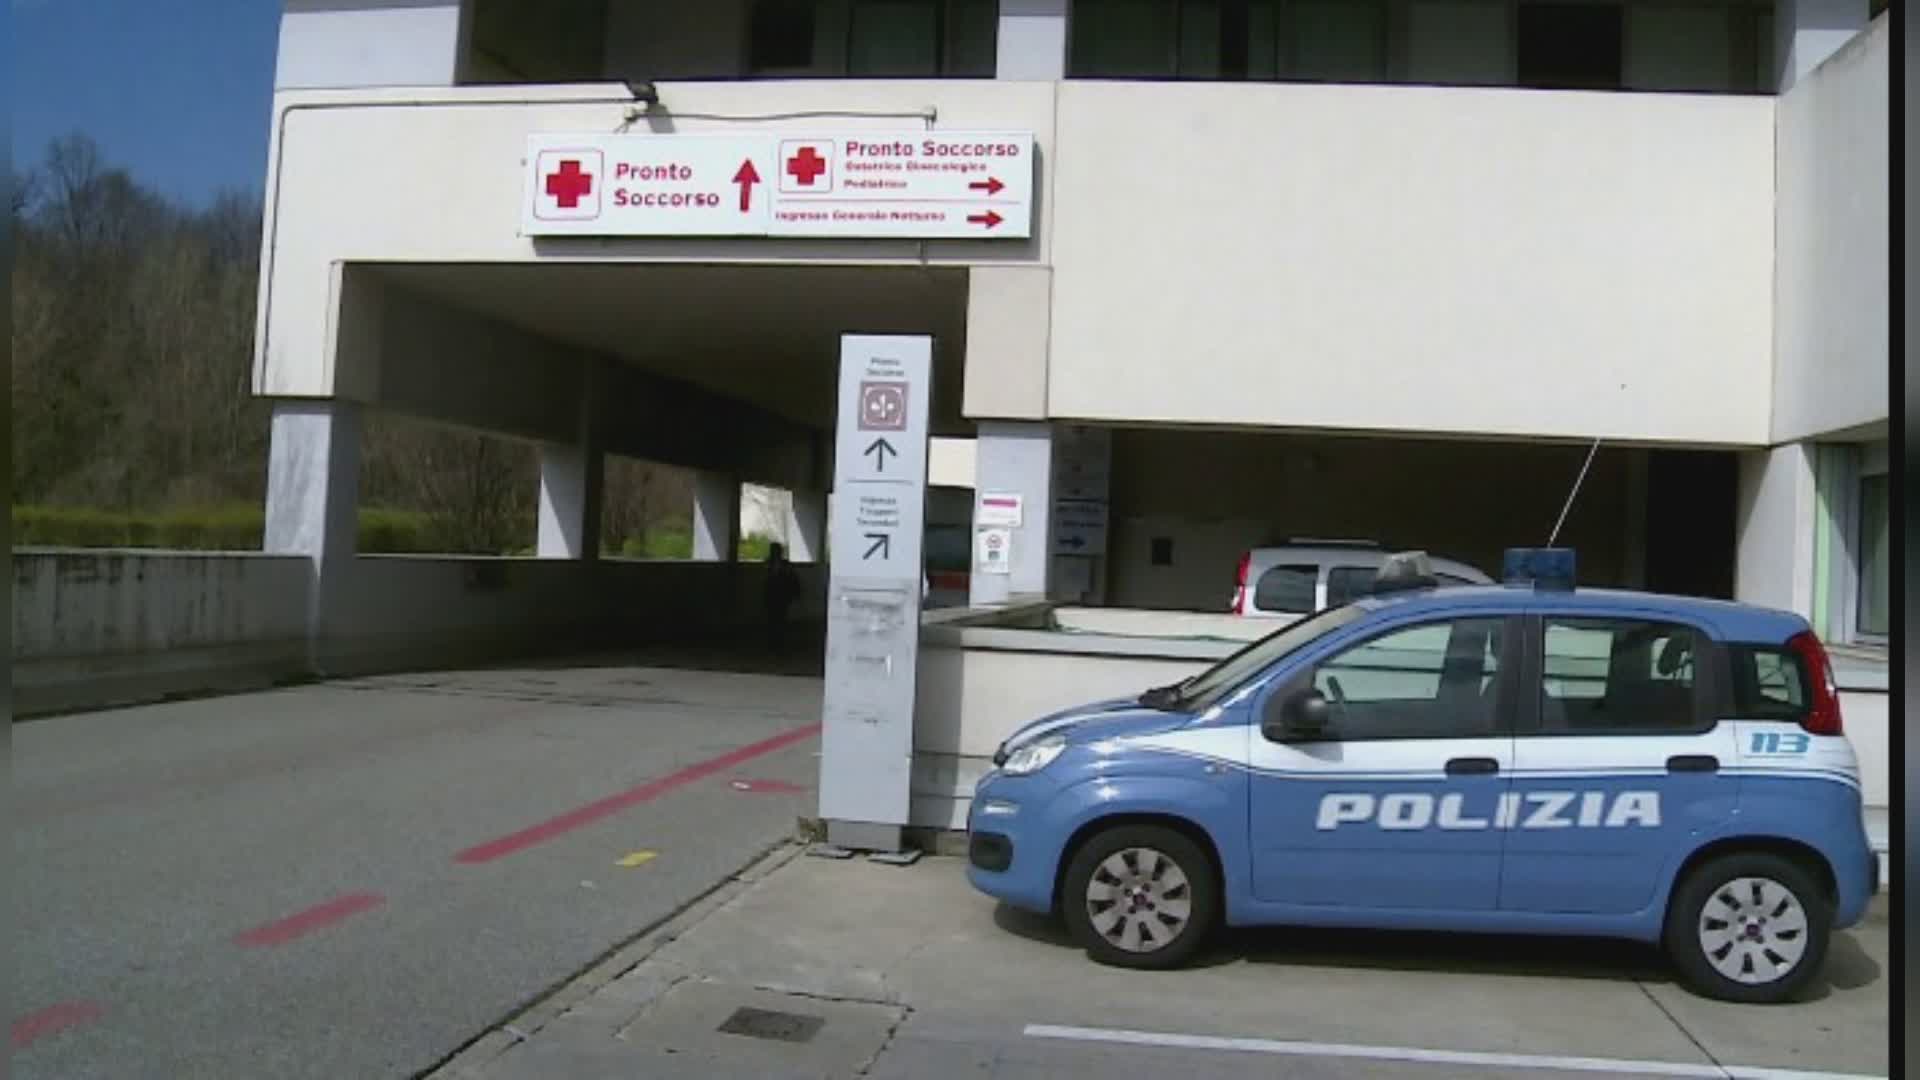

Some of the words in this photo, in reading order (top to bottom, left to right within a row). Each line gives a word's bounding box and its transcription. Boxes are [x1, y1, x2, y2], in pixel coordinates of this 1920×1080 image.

[846, 141, 913, 157] Pronto
[922, 140, 1020, 157] Soccorso
[616, 163, 692, 180] Pronto
[614, 187, 720, 206] Soccorso
[1751, 732, 1810, 752] 113
[1315, 791, 1661, 830] POLIZIA
